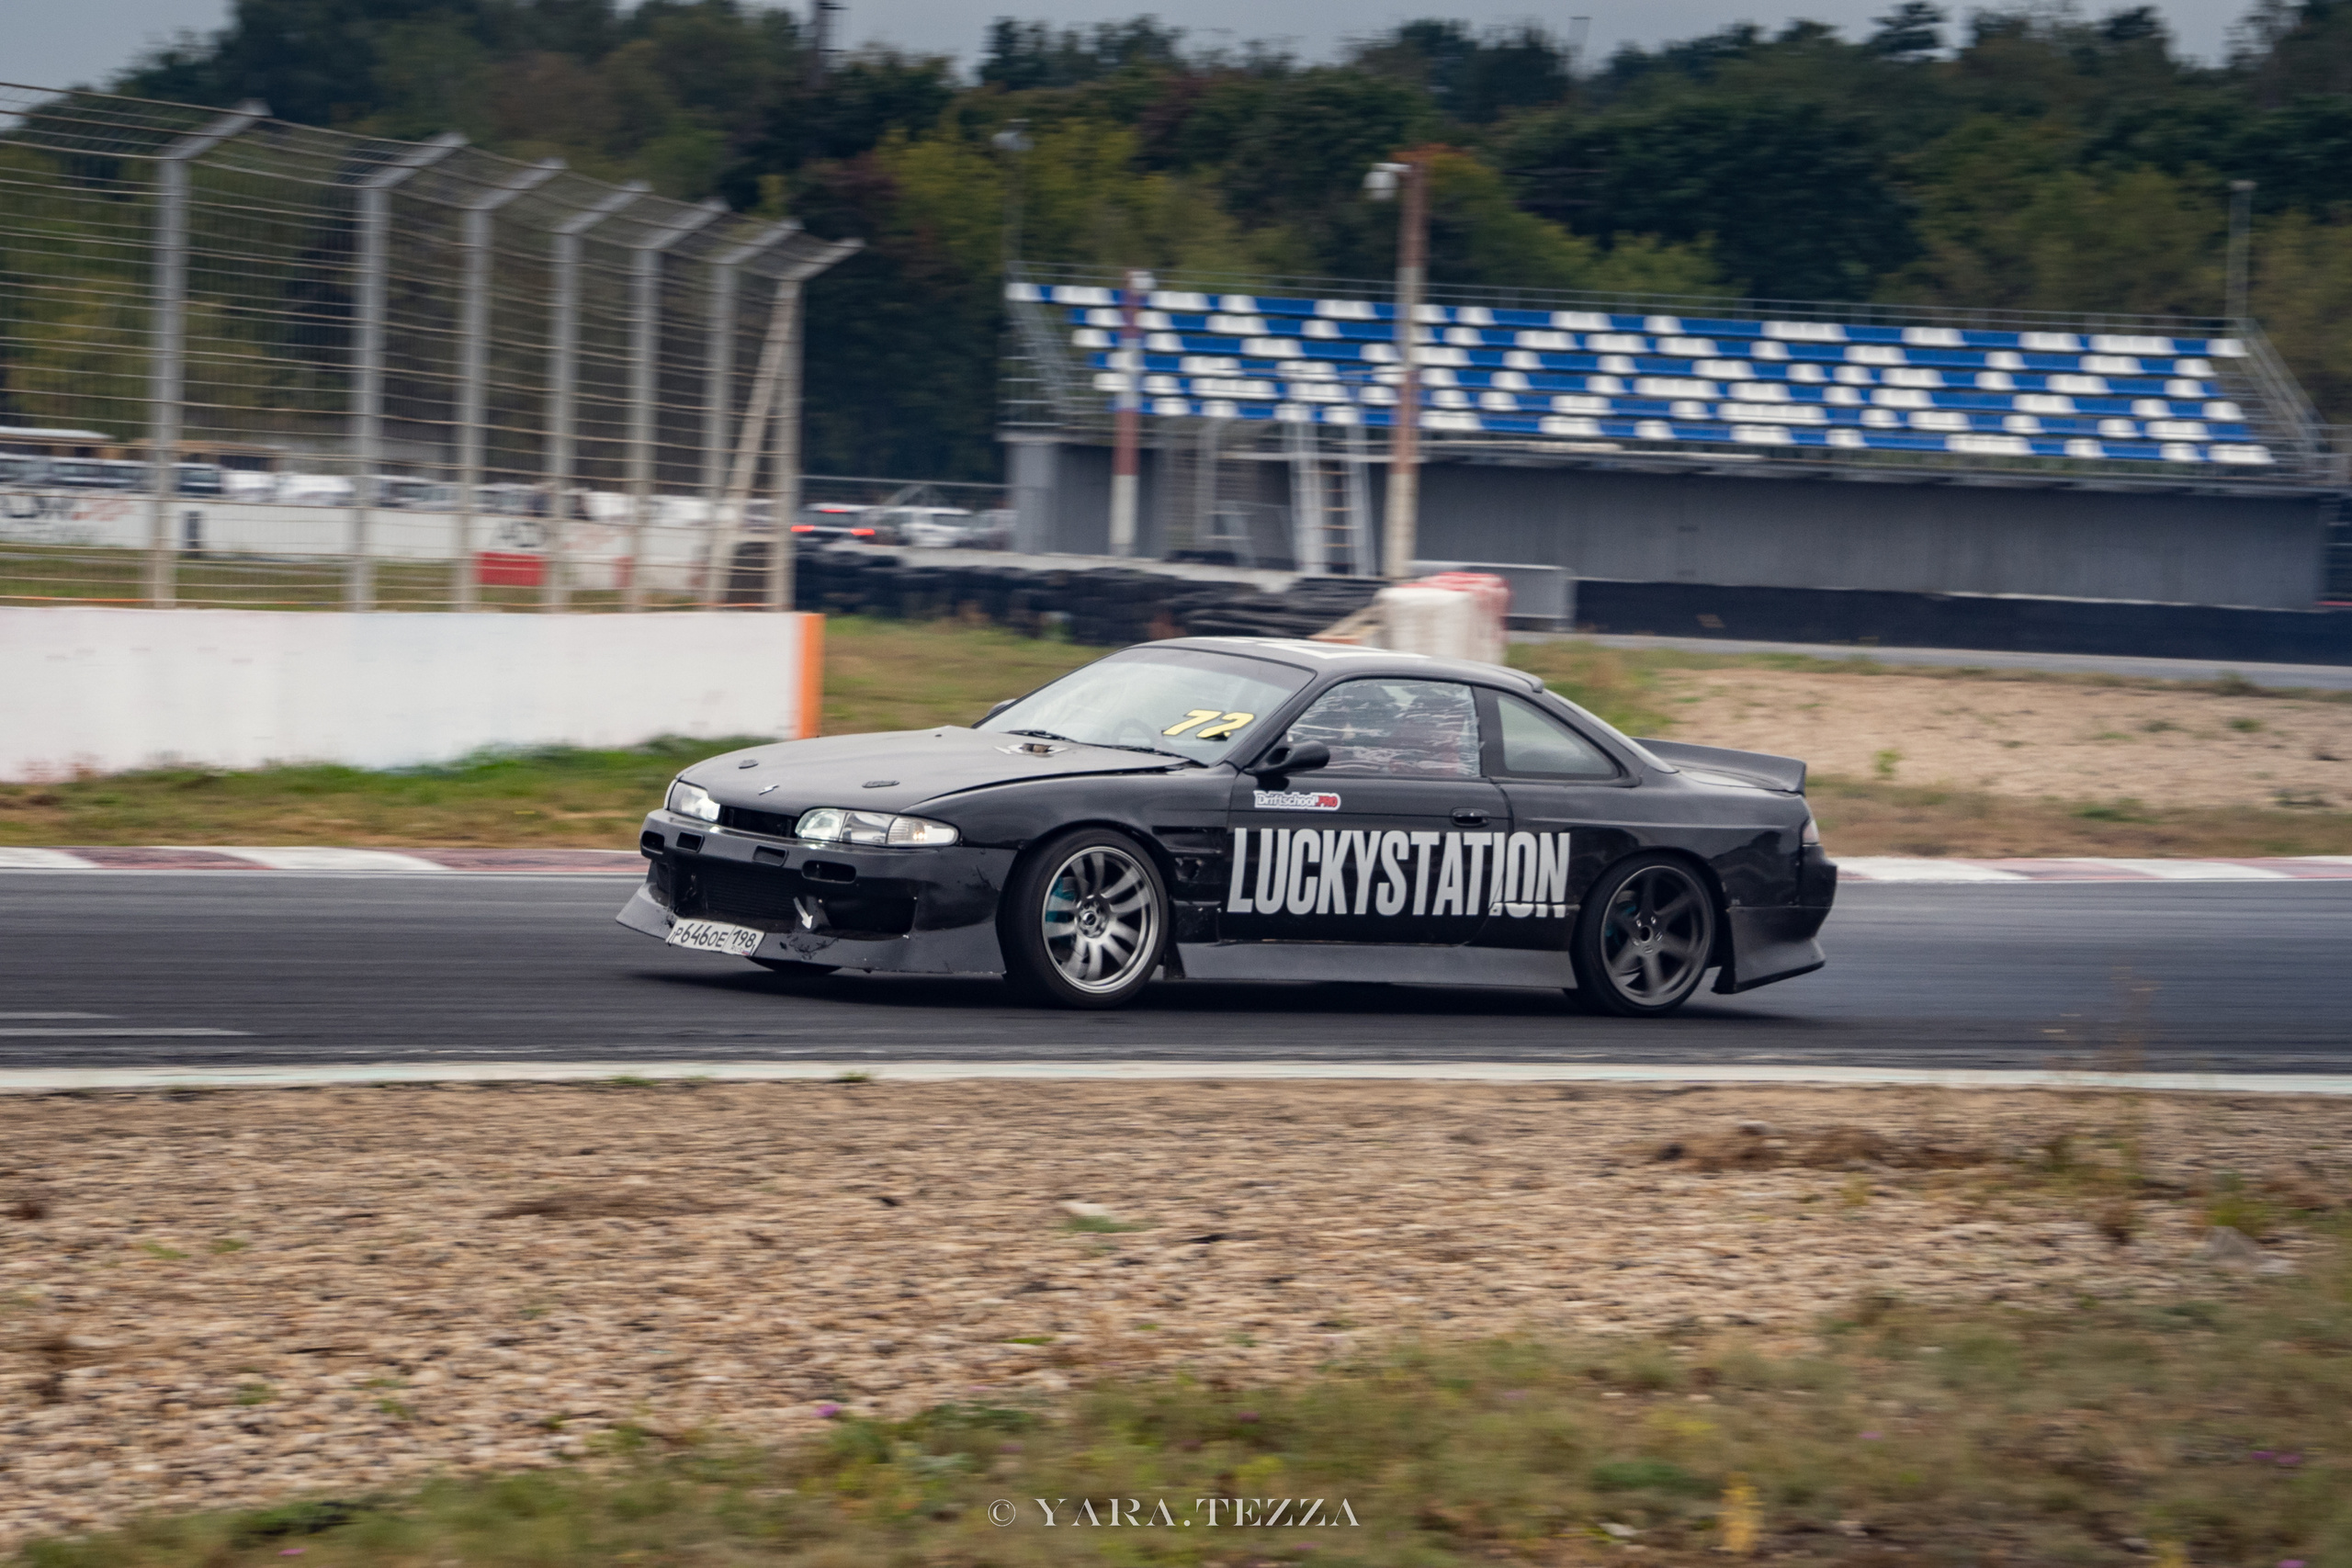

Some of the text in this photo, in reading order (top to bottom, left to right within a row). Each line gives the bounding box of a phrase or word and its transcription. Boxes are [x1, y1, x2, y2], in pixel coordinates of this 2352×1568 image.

[1162, 709, 1255, 740] 72
[1227, 828, 1571, 919] LUCKYSTATION
[732, 929, 757, 948] 198
